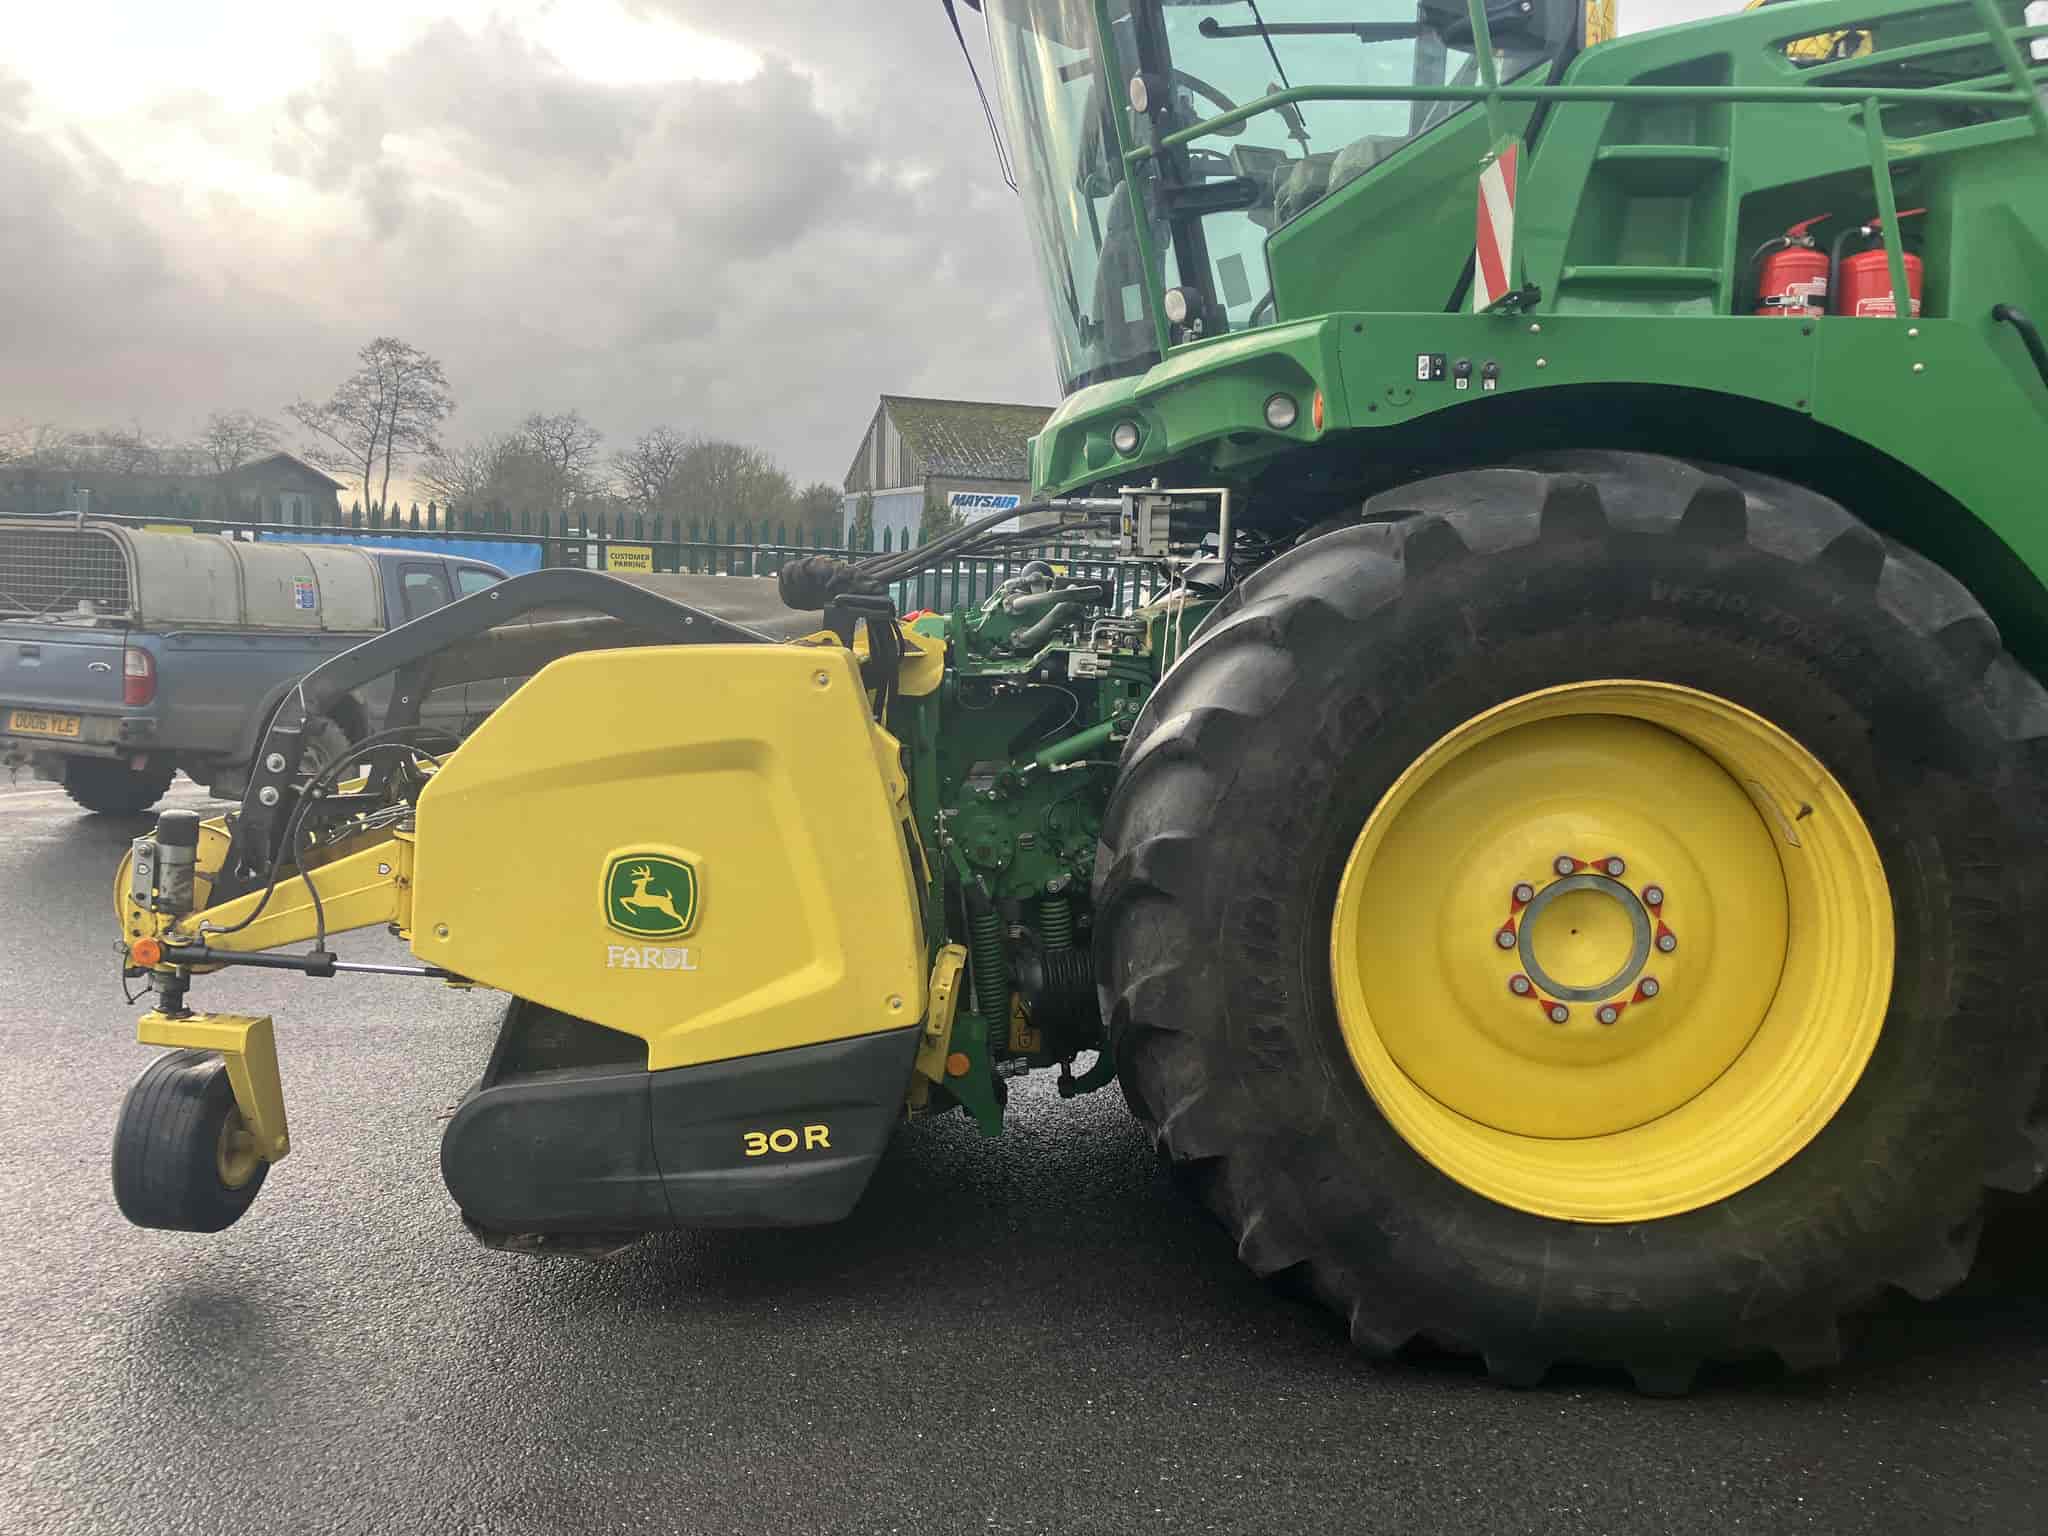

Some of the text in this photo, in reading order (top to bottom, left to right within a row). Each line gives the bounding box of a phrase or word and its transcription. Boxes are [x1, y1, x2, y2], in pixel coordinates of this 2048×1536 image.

[951, 494, 1019, 510] MAYSAIR
[610, 552, 650, 561] CUSTOMER
[614, 560, 647, 569] PARKING
